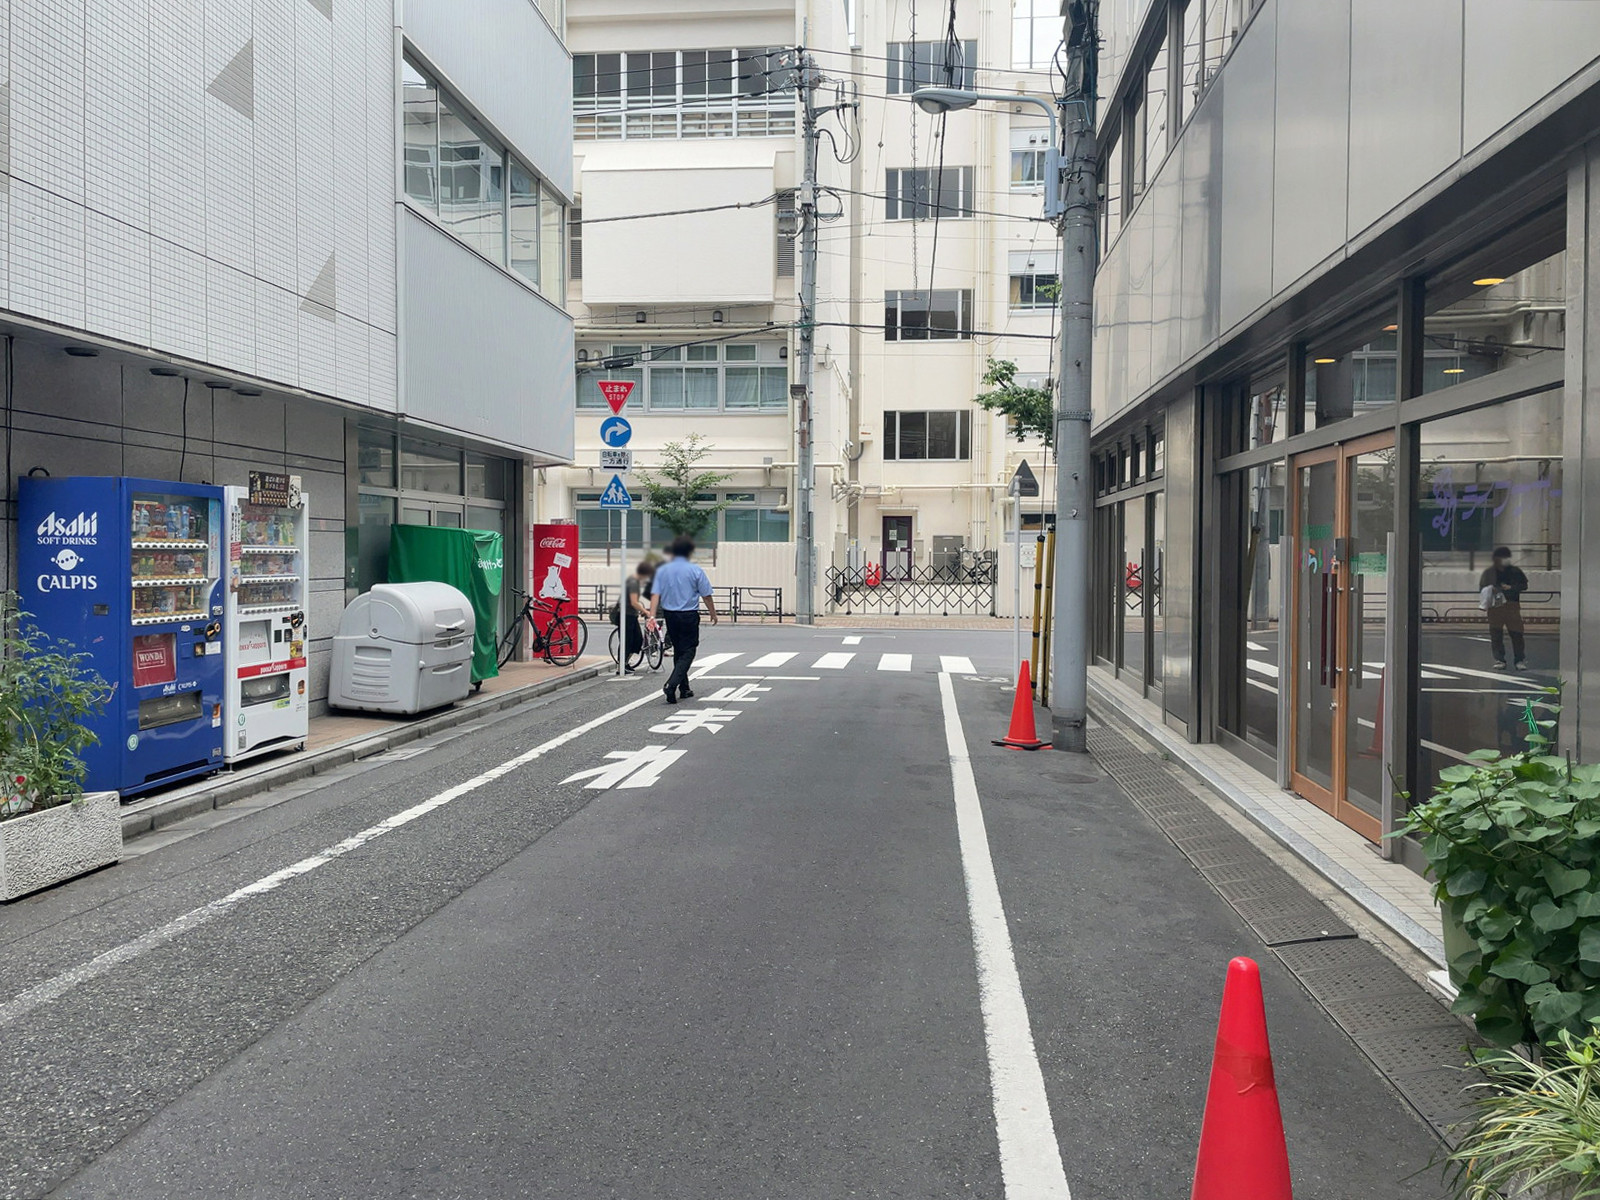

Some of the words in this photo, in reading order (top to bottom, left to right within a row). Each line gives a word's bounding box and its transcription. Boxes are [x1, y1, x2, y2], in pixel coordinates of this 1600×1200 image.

[605, 384, 628, 393] 止まれ
[608, 393, 625, 401] STOP
[602, 457, 630, 465] 一方通行
[37, 511, 98, 537] Asahi
[37, 536, 61, 545] SOFT
[62, 536, 98, 546] DRINKS
[37, 574, 98, 593] CALPIS
[138, 651, 164, 662] WONDA
[557, 683, 772, 789] 止まれ
